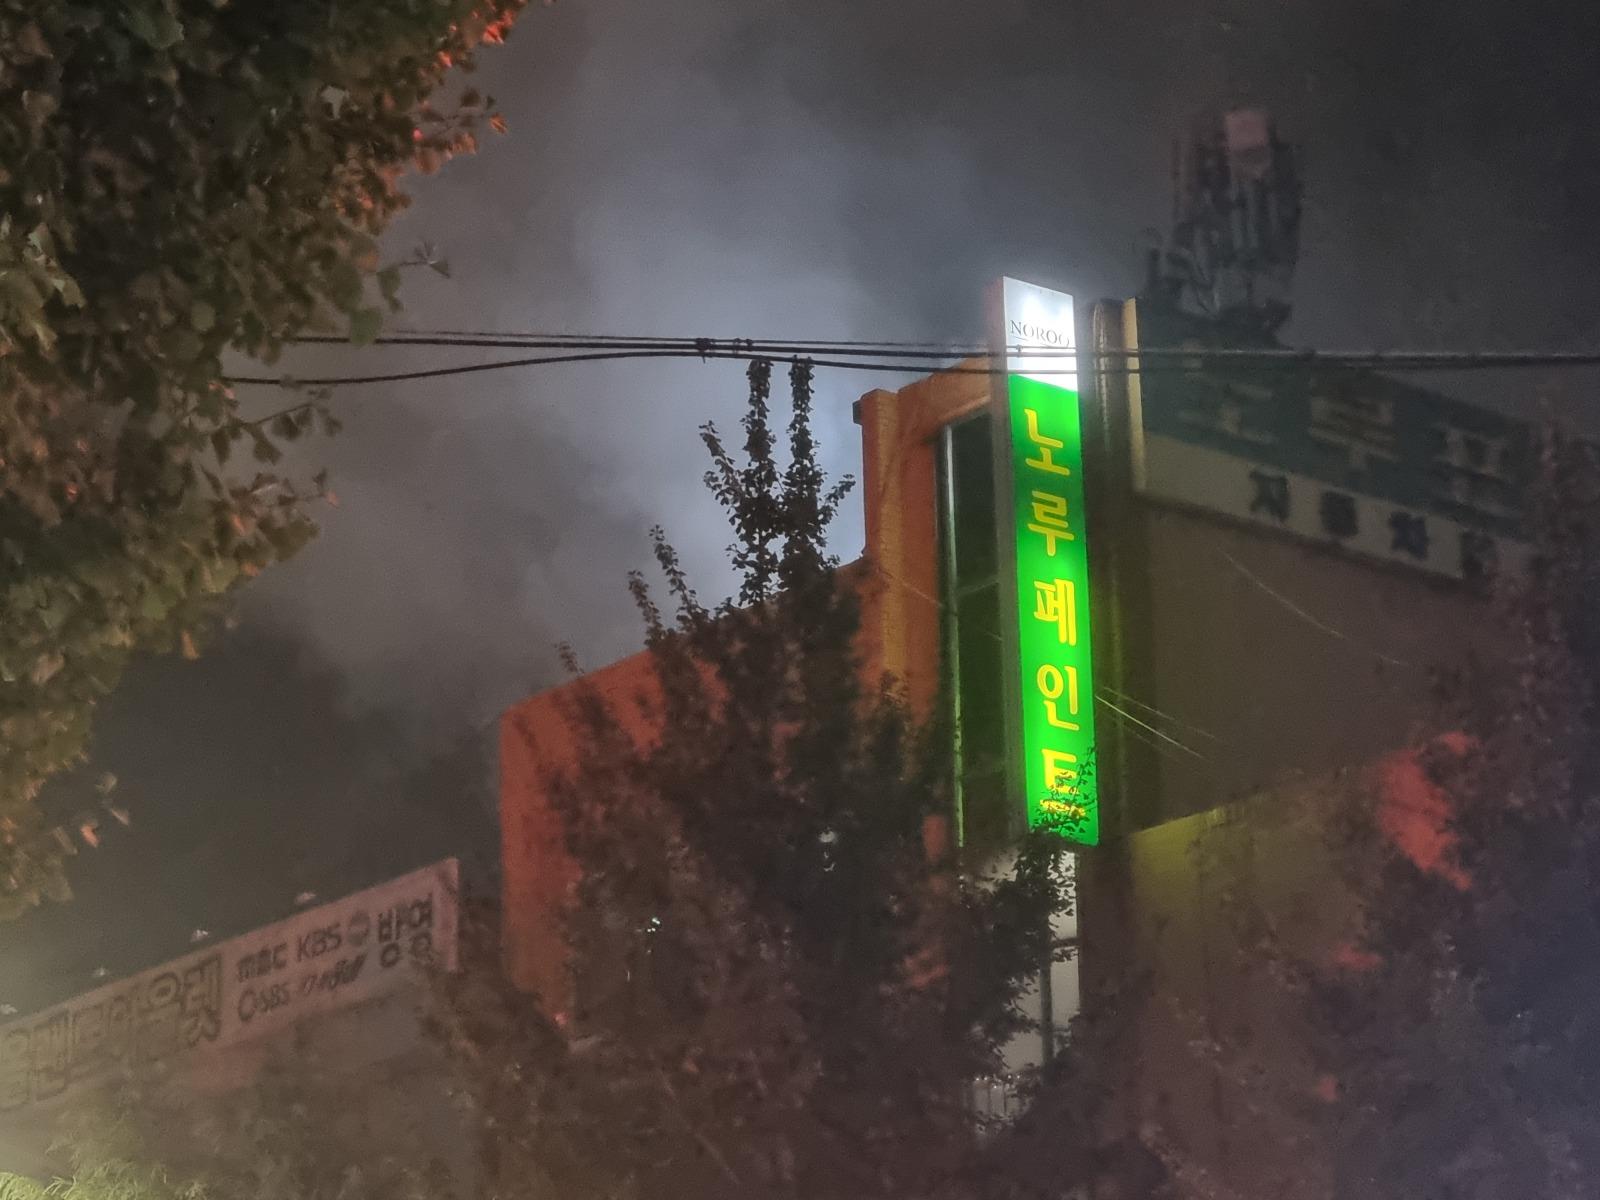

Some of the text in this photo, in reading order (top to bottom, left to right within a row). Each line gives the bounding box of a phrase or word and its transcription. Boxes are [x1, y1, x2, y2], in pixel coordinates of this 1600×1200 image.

[1010, 319, 1070, 347] NOROO
[1024, 408, 1086, 818] 노루페인트
[297, 922, 342, 962] KBS
